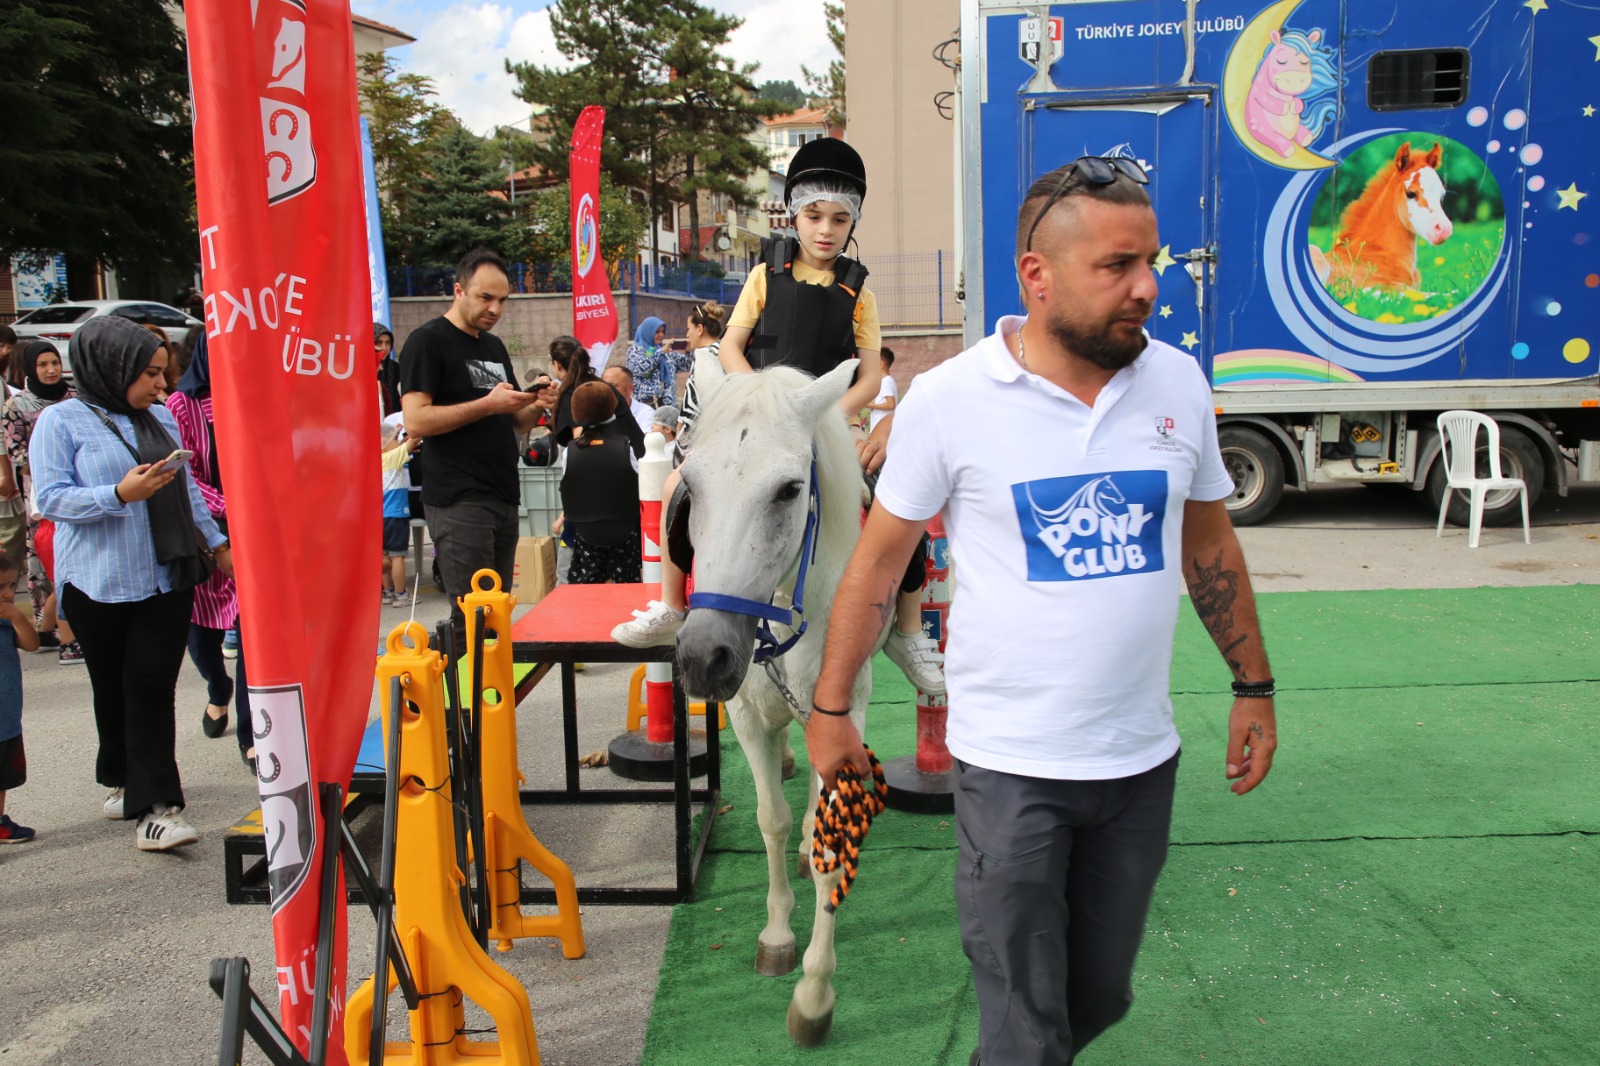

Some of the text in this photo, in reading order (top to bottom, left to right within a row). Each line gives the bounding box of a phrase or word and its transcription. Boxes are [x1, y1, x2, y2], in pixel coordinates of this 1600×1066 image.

[1076, 23, 1134, 40] TÜRKİYE
[1138, 22, 1182, 36] JOKEY
[1037, 504, 1153, 558] PONY
[1063, 544, 1147, 577] CLUB
